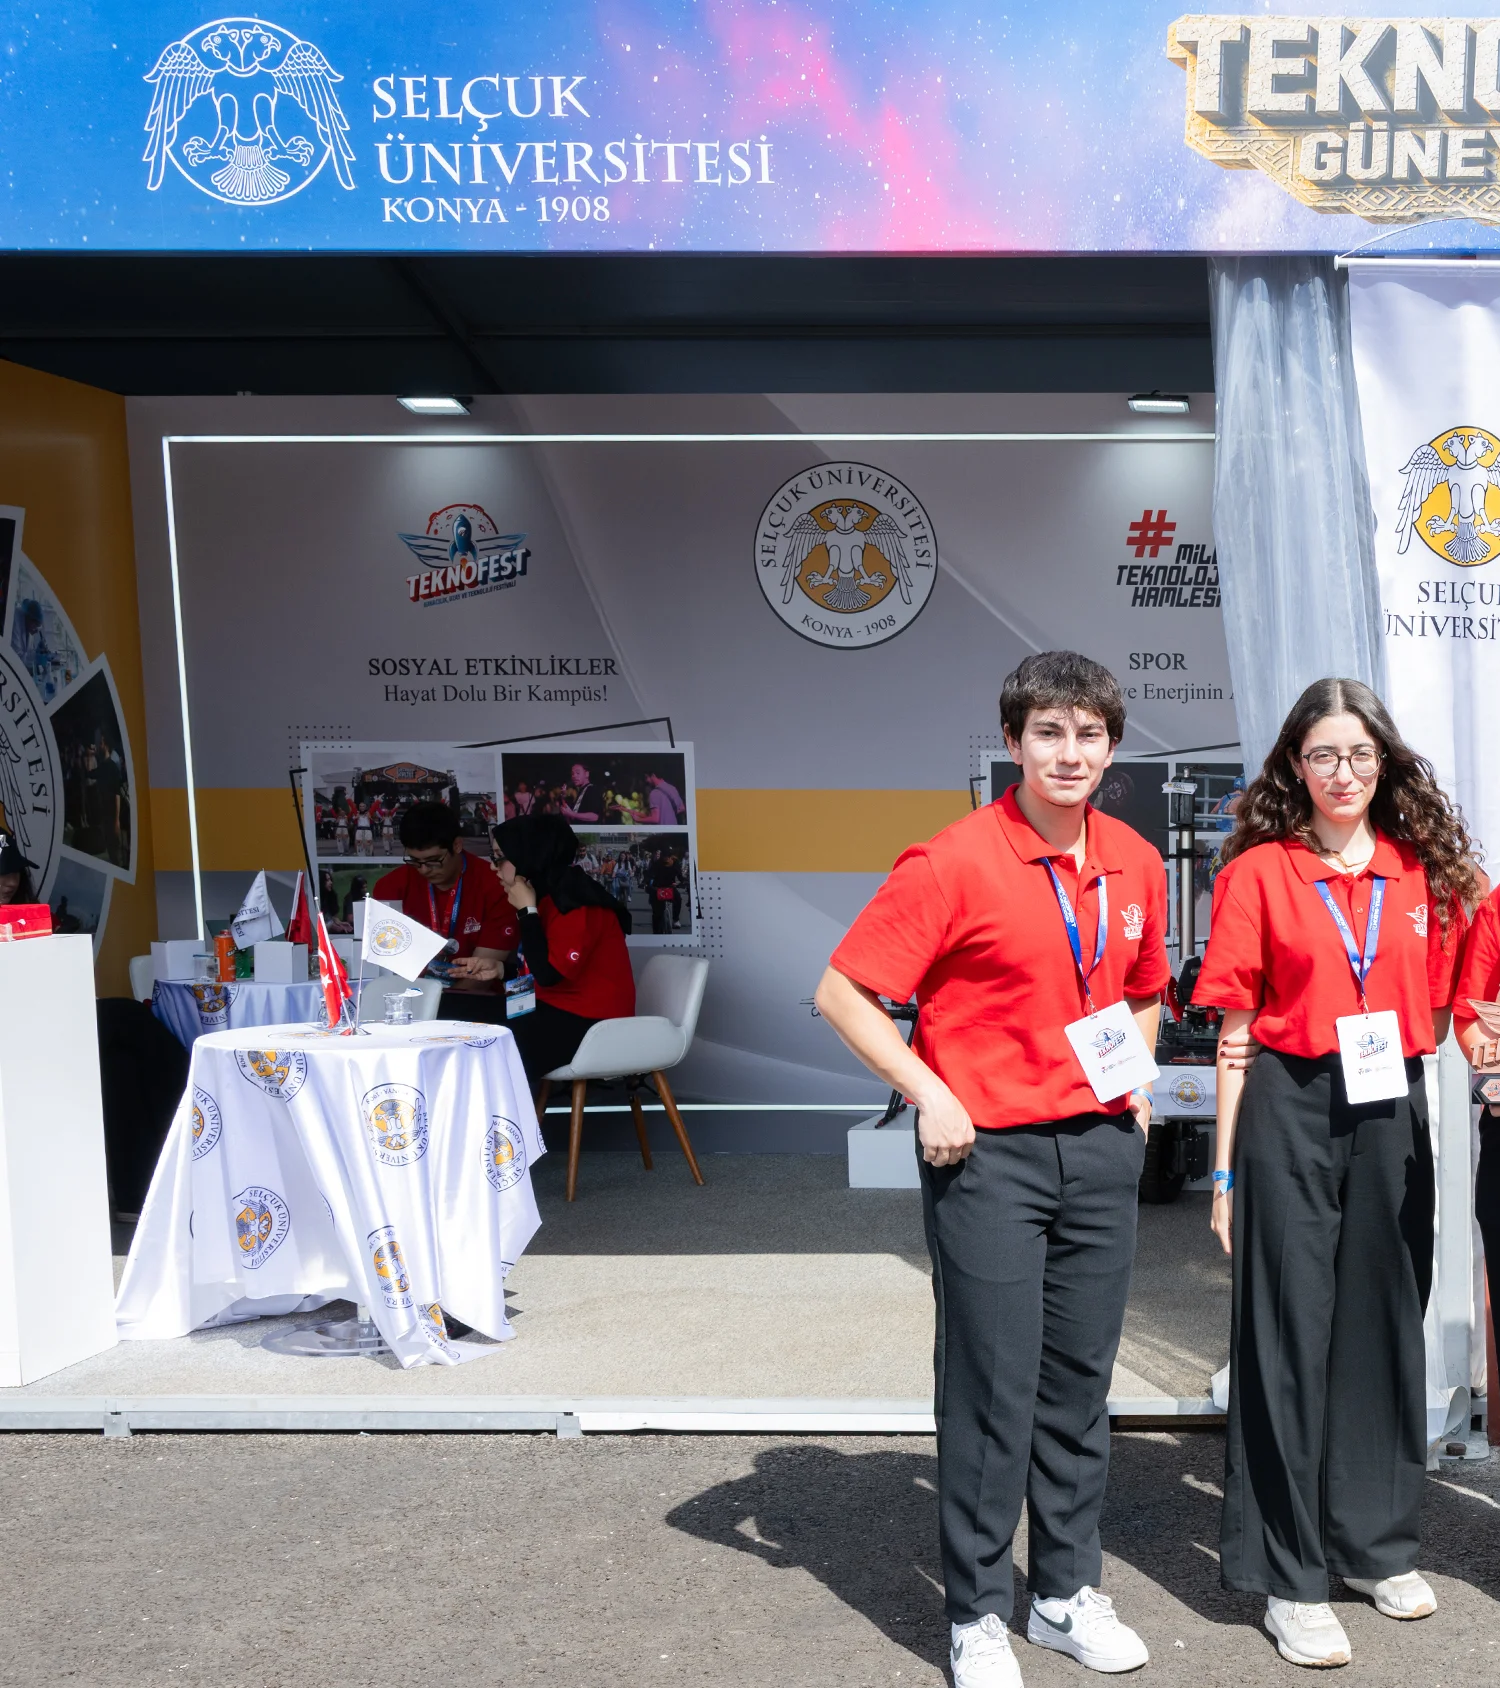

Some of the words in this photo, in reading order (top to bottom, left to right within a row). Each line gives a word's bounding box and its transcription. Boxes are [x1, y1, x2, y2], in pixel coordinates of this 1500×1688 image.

[372, 73, 592, 131] SELÇUK
[373, 132, 776, 188] ÜNİVERSİTESİ
[381, 196, 509, 224] KONYA
[535, 195, 611, 223] 1908
[761, 482, 808, 568] SELÇUK
[806, 466, 933, 570] ÜNİVERSİTESİ
[1175, 543, 1218, 565] MİL
[405, 548, 532, 603] TEKNOFEST
[1116, 564, 1219, 586] TEKNOLOJ
[801, 613, 853, 638] KONYA
[864, 614, 896, 636] 1908
[368, 657, 459, 676] SOSYAL
[464, 654, 620, 676] ETKİNLİKLER
[1129, 652, 1188, 671] SPOR
[384, 684, 437, 706] Hayat
[443, 684, 487, 702] Dolu
[492, 684, 522, 702] Bir
[527, 684, 608, 706] Kampüs!
[1143, 683, 1223, 704] Enerjinin
[249, 1189, 284, 1212] SELÇUK
